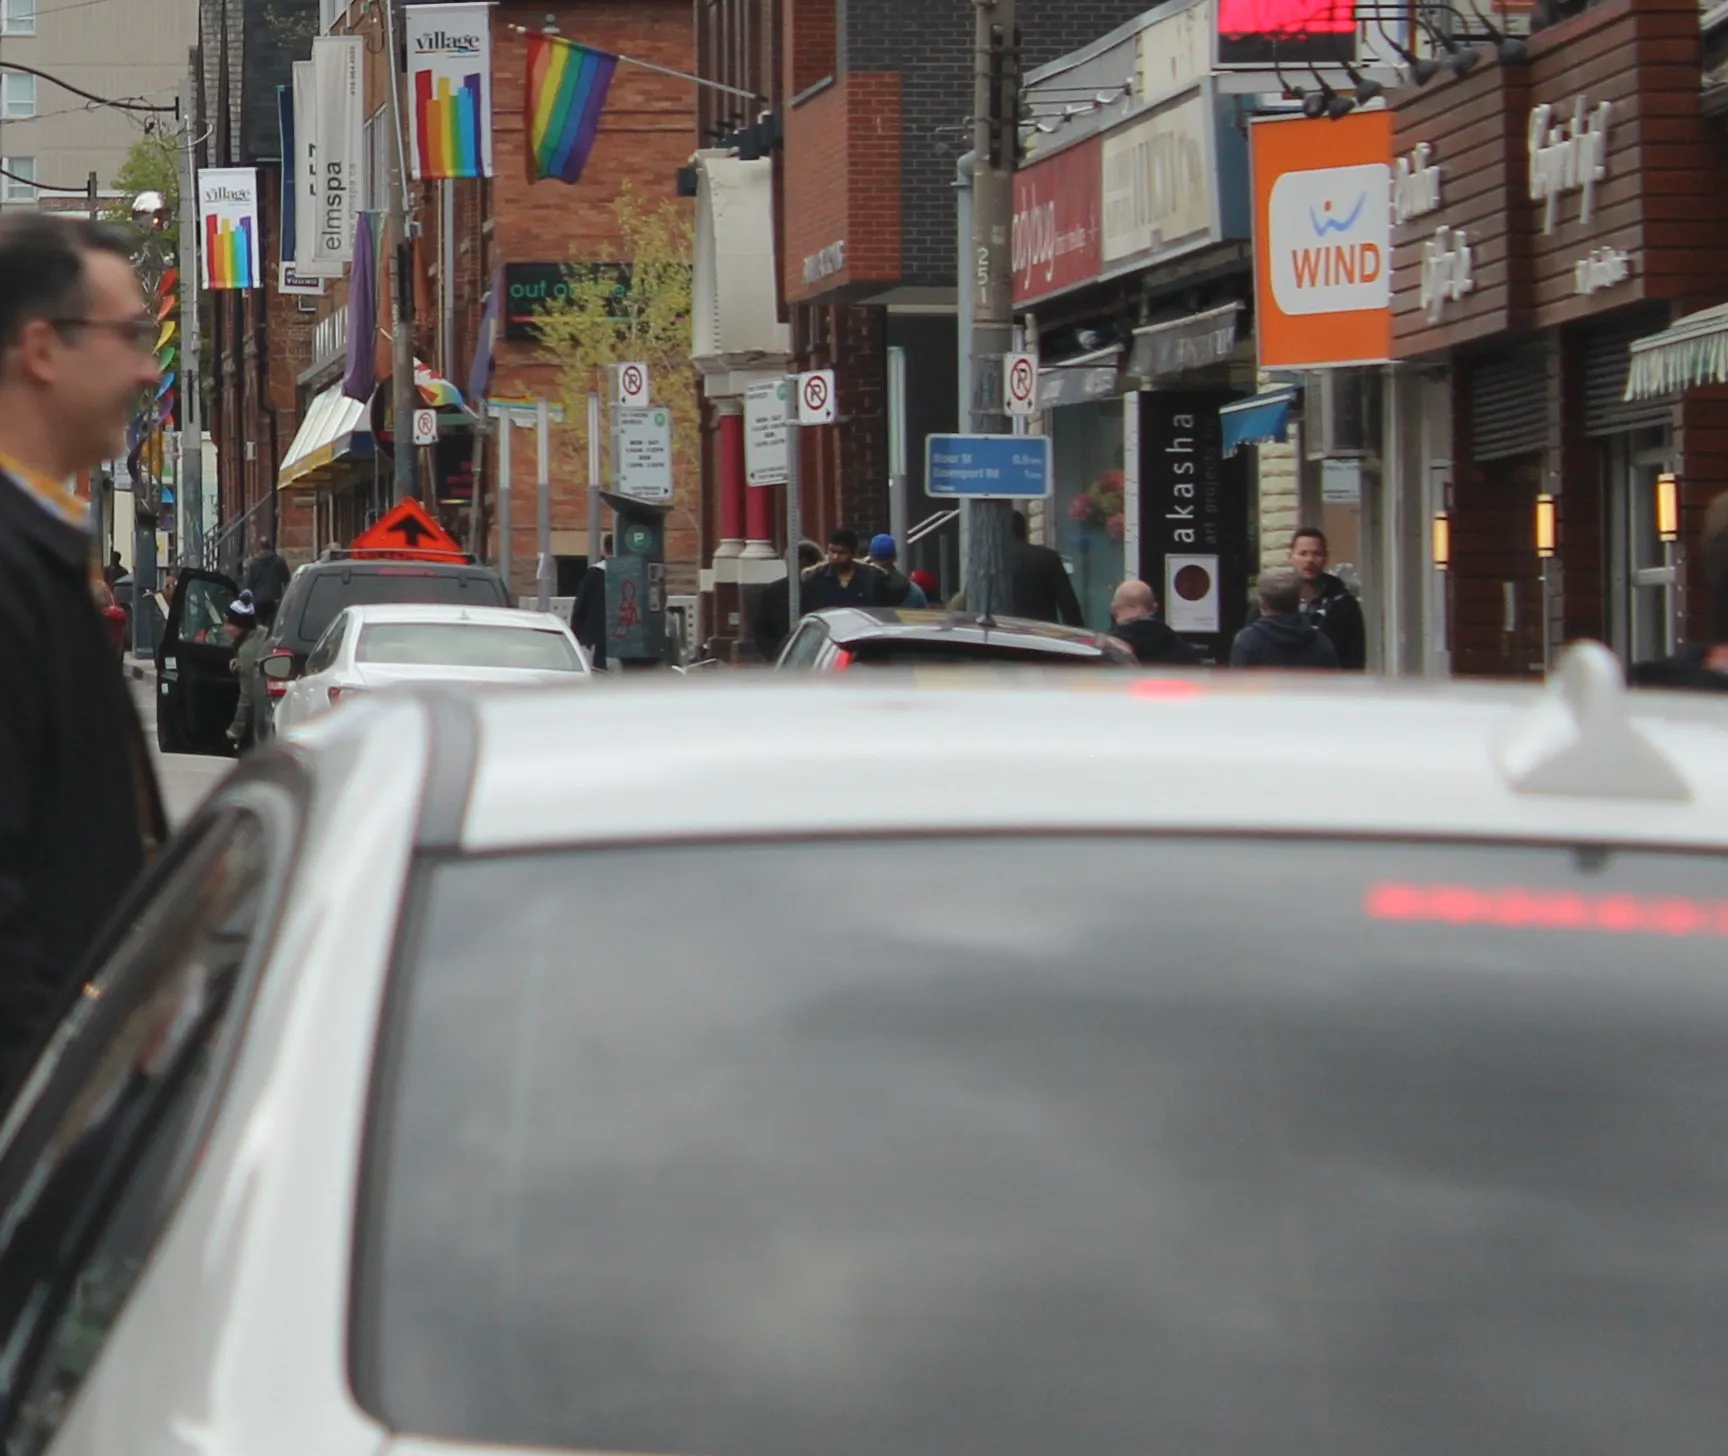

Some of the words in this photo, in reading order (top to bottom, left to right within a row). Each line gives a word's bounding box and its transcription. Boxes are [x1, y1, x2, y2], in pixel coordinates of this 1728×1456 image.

[415, 31, 481, 55] village
[205, 187, 252, 203] village
[322, 160, 347, 251] elmspa
[1011, 182, 1055, 291] adybug
[509, 280, 547, 298] out
[1291, 241, 1382, 290] WIND
[1164, 413, 1195, 543] akasha
